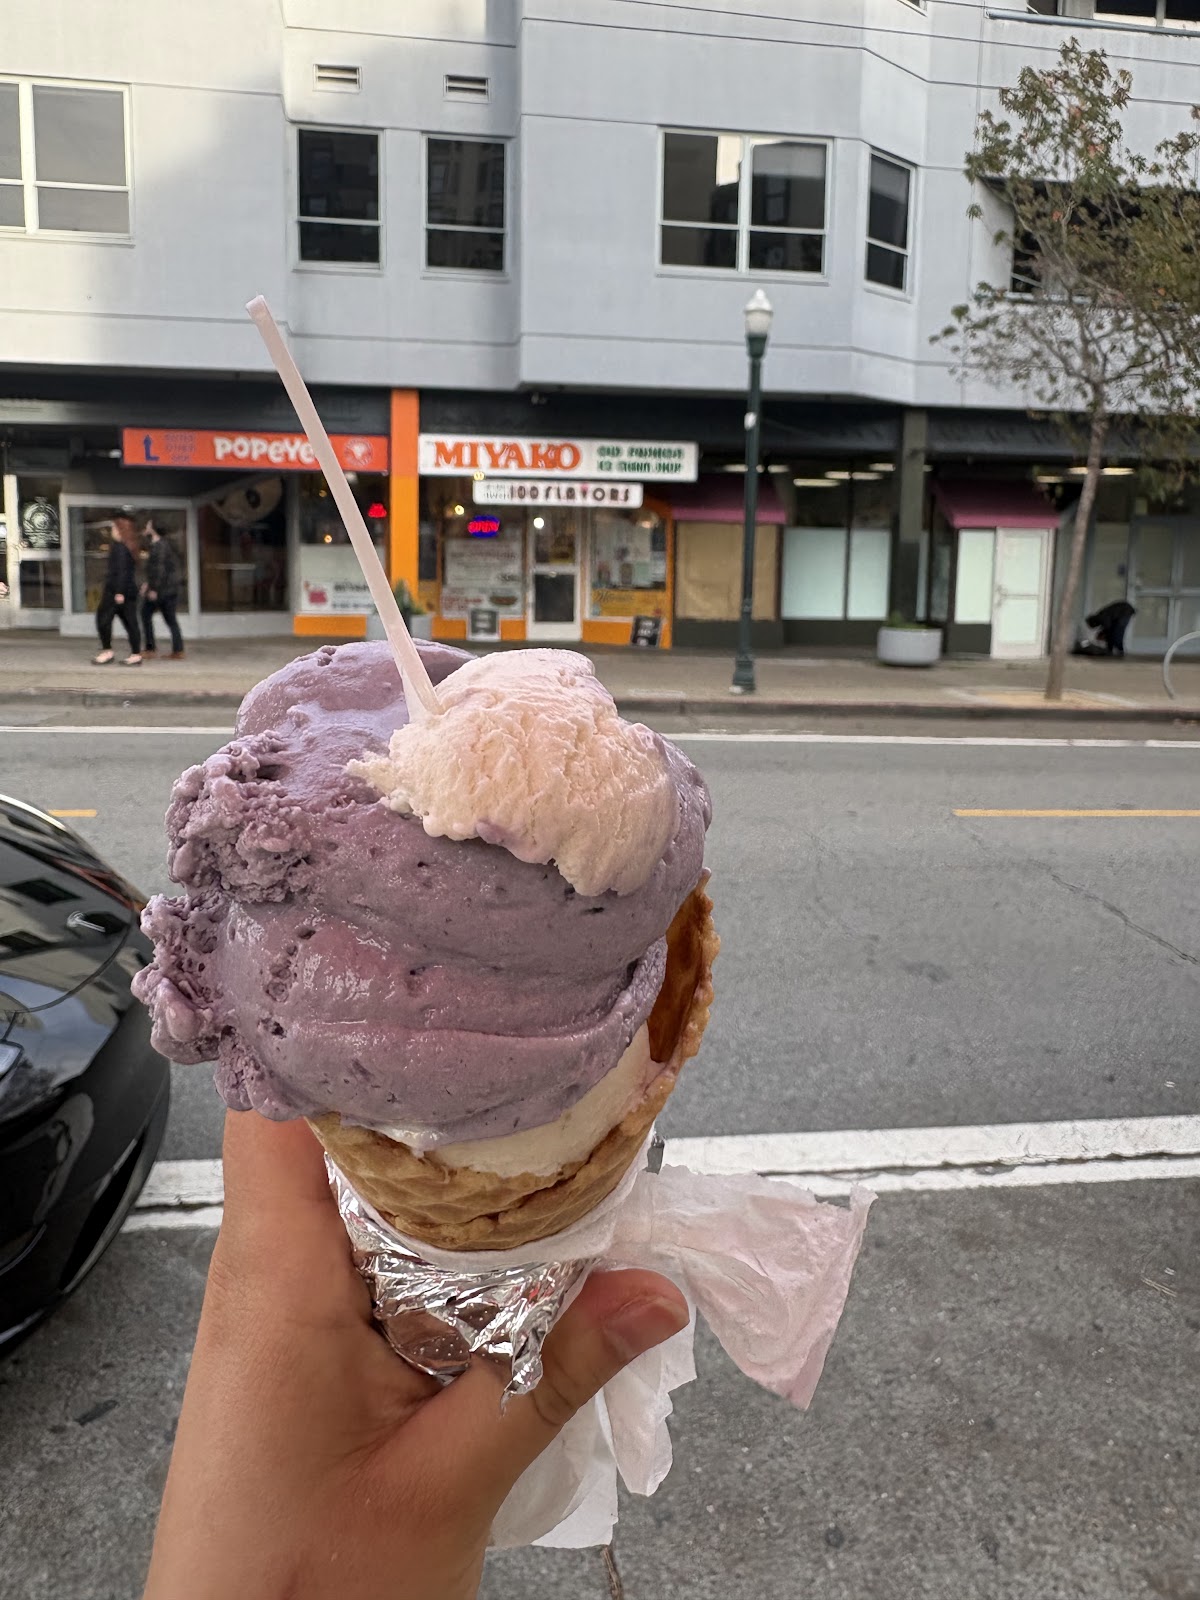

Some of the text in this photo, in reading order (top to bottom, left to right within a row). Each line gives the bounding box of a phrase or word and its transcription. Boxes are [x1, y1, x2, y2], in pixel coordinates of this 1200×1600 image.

[213, 436, 317, 463] POPEYE
[434, 441, 581, 471] MIYAKO
[510, 484, 539, 500] 100
